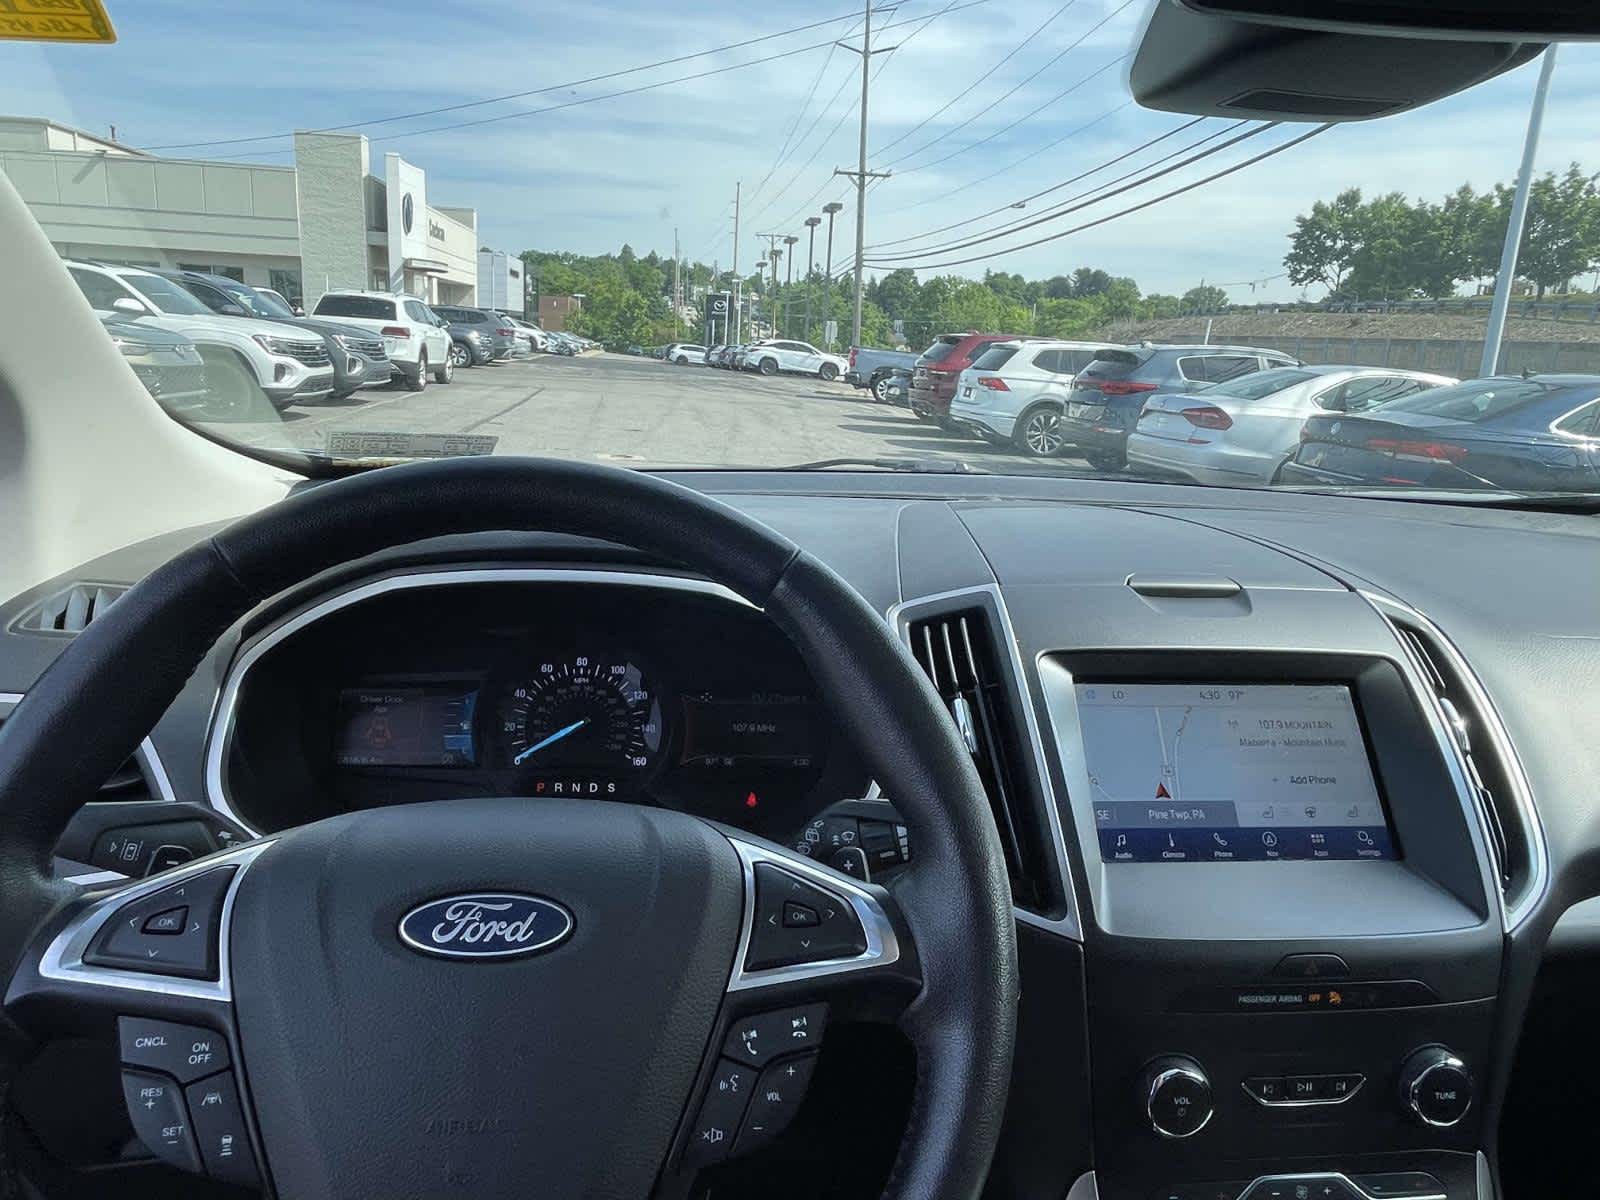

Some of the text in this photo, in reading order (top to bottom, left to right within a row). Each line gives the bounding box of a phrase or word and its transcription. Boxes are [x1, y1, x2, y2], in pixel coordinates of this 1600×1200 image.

[541, 664, 553, 673] 60
[611, 666, 626, 674] 100
[515, 689, 526, 698] 40
[633, 691, 648, 700] 120
[504, 723, 516, 731] 20
[641, 724, 655, 733] 140
[632, 757, 647, 766] 160
[1290, 775, 1337, 784] Add Phone
[536, 783, 616, 792] P R N D S
[1148, 809, 1168, 819] Pine
[1193, 809, 1206, 819] PA
[792, 911, 808, 921] OK
[158, 918, 175, 927] OK
[432, 901, 537, 943] Ford
[135, 1036, 168, 1048] CNCL
[191, 1042, 210, 1052] ON
[188, 1053, 212, 1065] OFF
[140, 1087, 163, 1097] RES
[1434, 1091, 1456, 1100] TUNE
[766, 1092, 782, 1102] VOL
[1174, 1097, 1191, 1105] VOL
[162, 1125, 184, 1137] SET
